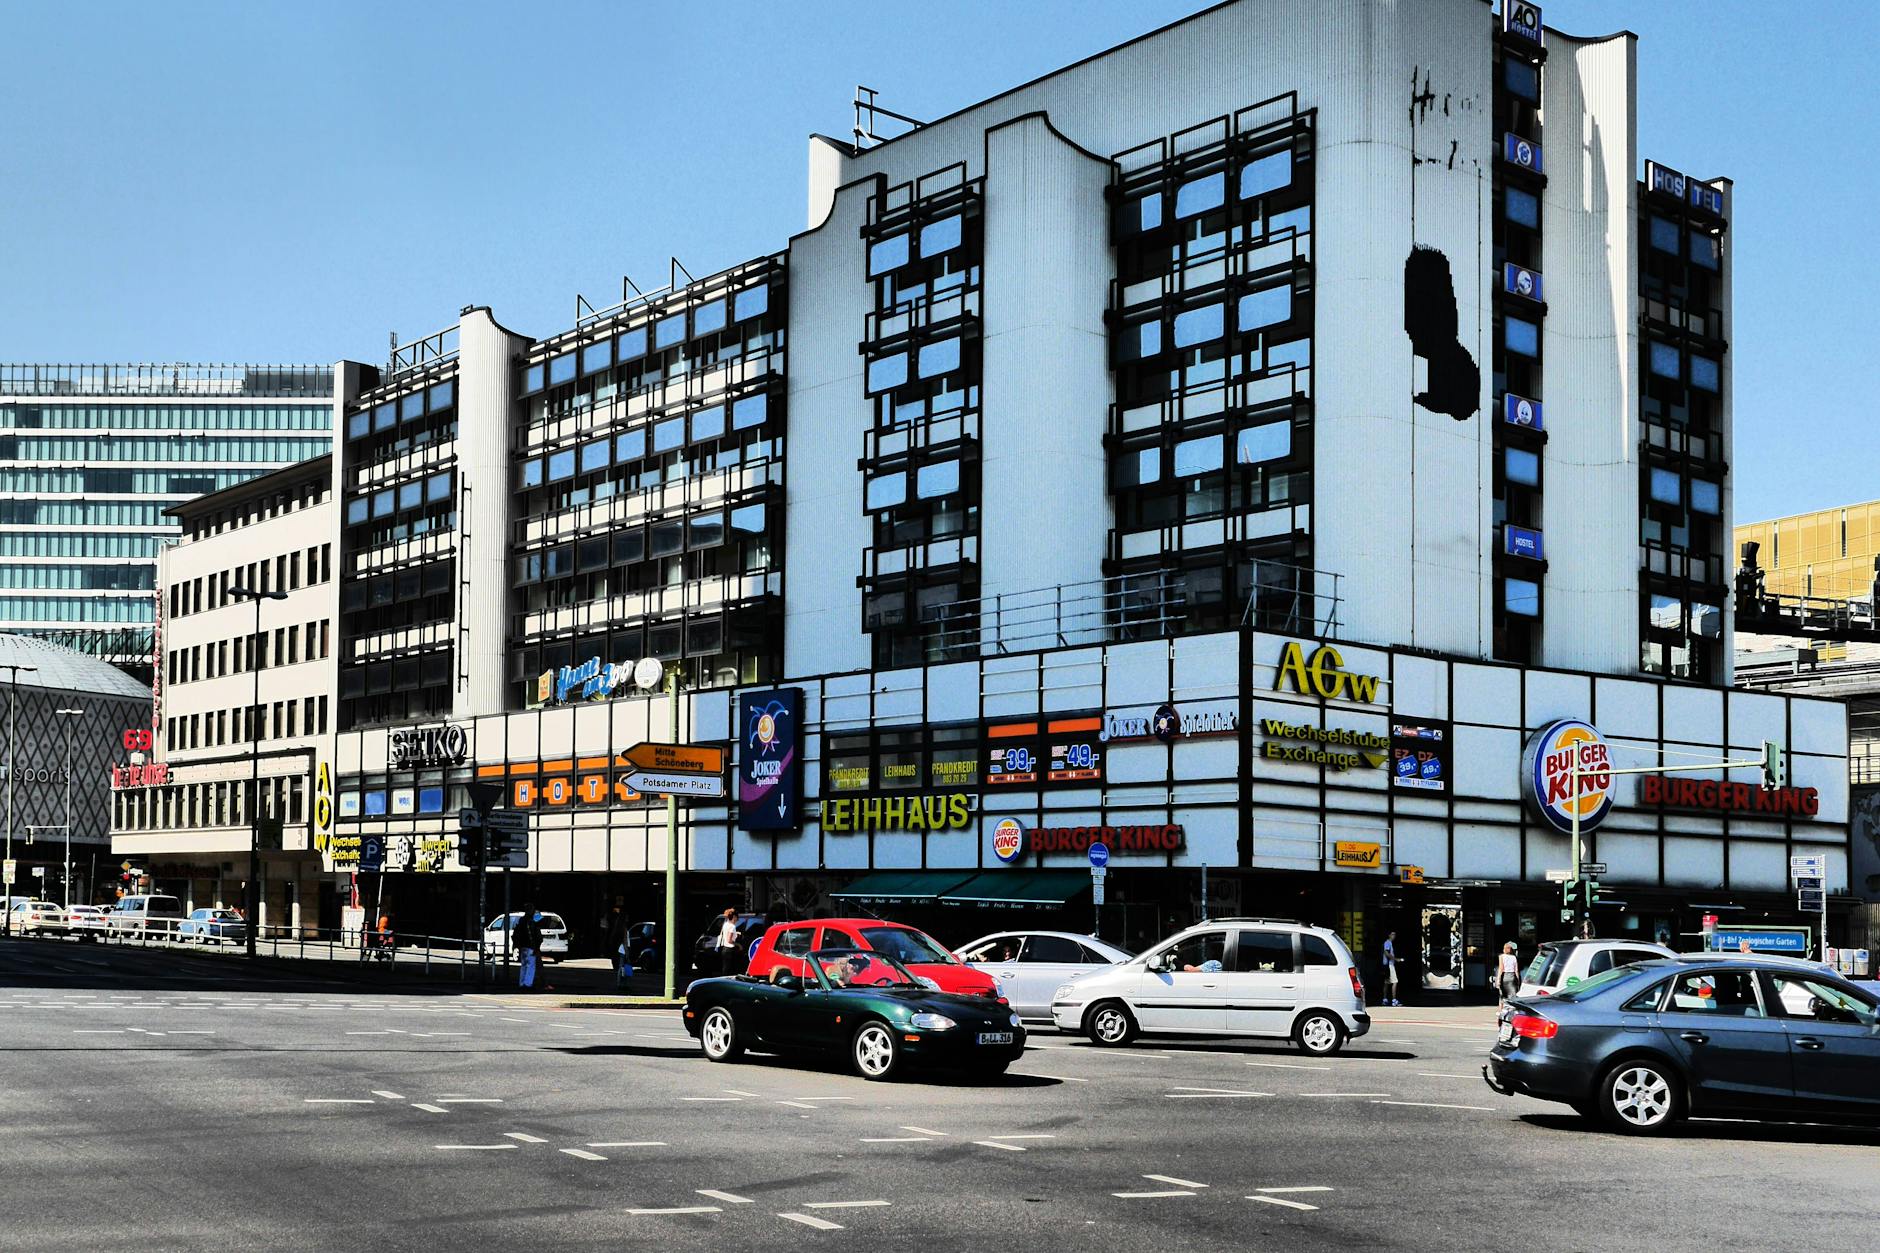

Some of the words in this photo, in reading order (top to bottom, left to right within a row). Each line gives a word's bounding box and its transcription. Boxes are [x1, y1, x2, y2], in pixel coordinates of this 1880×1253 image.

[1511, 21, 1538, 41] HOSTEL
[1515, 536, 1535, 549] HOSTEL
[1100, 714, 1148, 742] JOKER
[1179, 710, 1237, 738] Spielothek
[1263, 718, 1392, 750] Wechselstube
[123, 729, 153, 751] 69
[391, 725, 467, 763] SEIKO
[655, 748, 676, 757] Mitte
[1265, 742, 1360, 772] Exchange
[655, 757, 704, 770] Schöneberg
[751, 759, 782, 778] JOKER
[884, 764, 917, 777] LEIHHAUS
[931, 760, 978, 775] PFANDKREDIT
[14, 766, 71, 786] sports
[829, 766, 870, 780] PFANDKREDIT
[642, 777, 688, 789] Potsdamer
[691, 781, 711, 790] Platz
[1643, 775, 1750, 811] BURGER
[1756, 784, 1819, 816] KING
[821, 793, 969, 832] LEIHHAUS
[994, 828, 1019, 839] BURGER
[994, 836, 1019, 848] KING
[1030, 826, 1116, 851] BURGER
[1120, 824, 1181, 850] KING
[1337, 850, 1368, 862] LEIHHAUS
[1776, 937, 1797, 946] Garten
